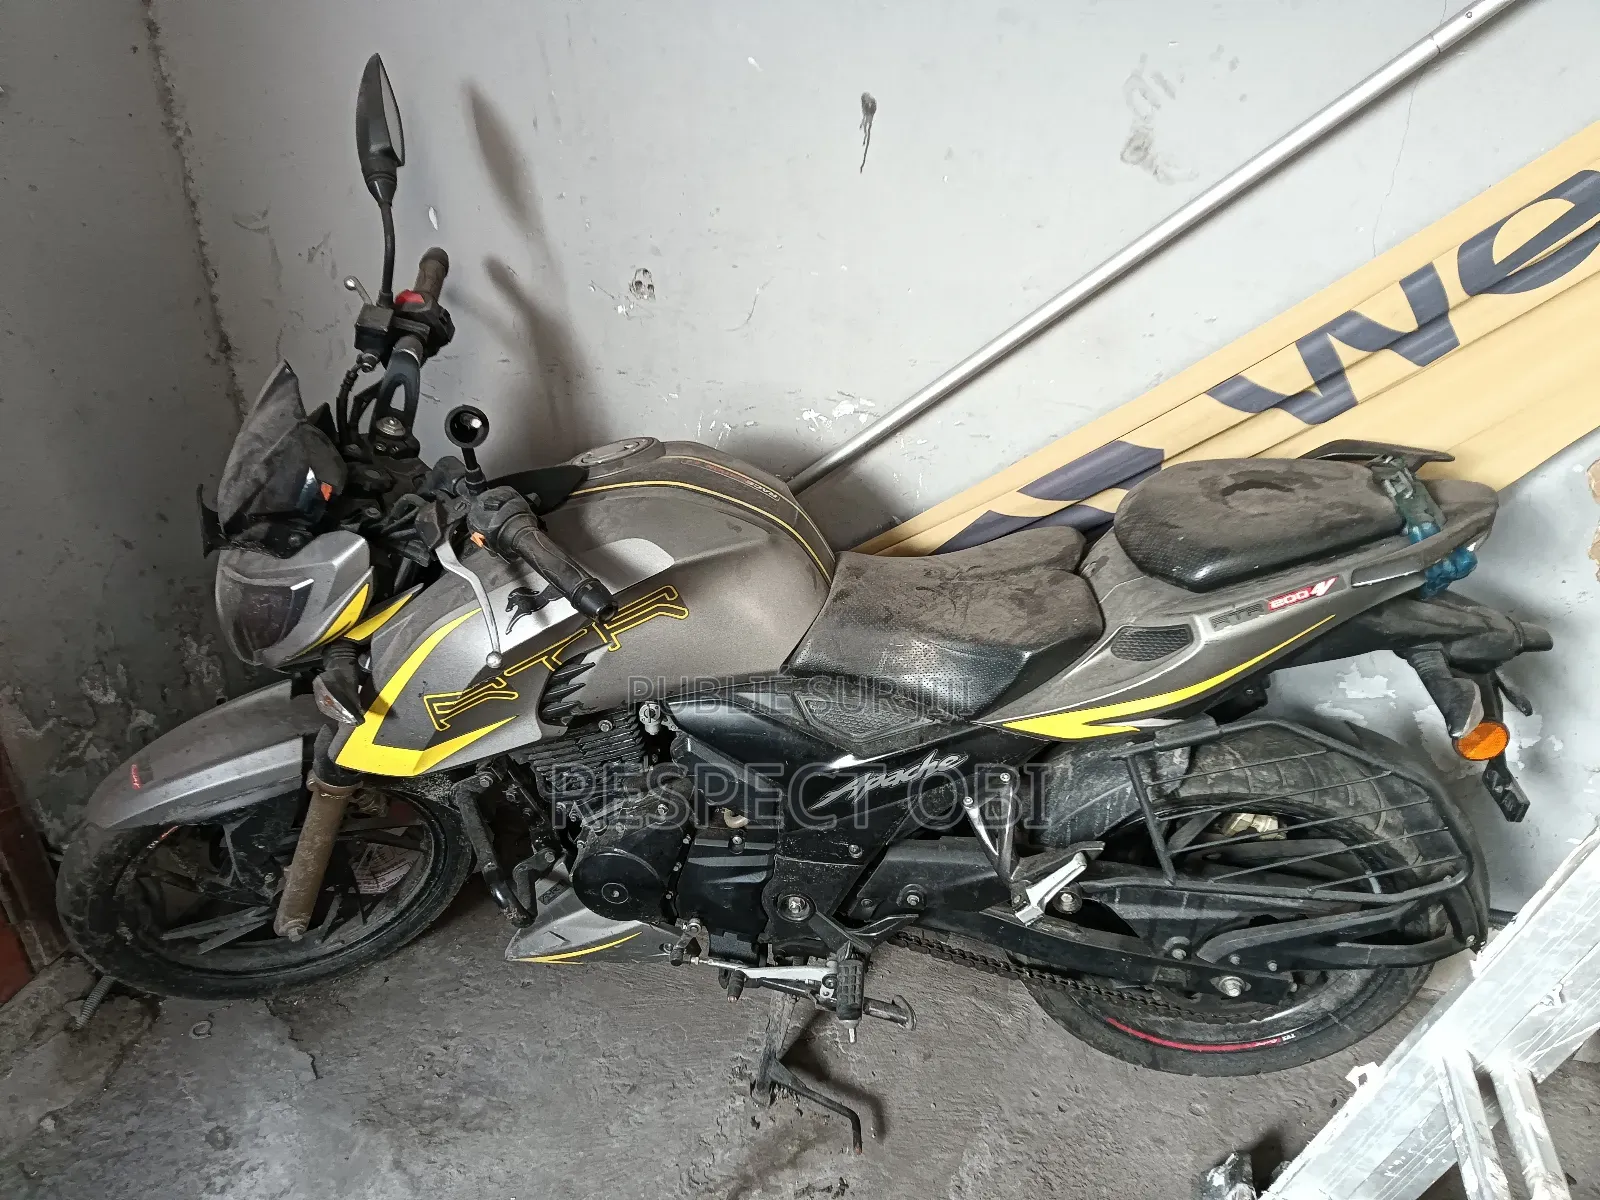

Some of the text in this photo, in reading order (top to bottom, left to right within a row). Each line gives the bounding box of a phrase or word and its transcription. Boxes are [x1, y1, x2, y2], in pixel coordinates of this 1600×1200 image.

[1211, 603, 1265, 629] RTR
[1270, 591, 1311, 610] 200
[808, 748, 968, 810] Apache
